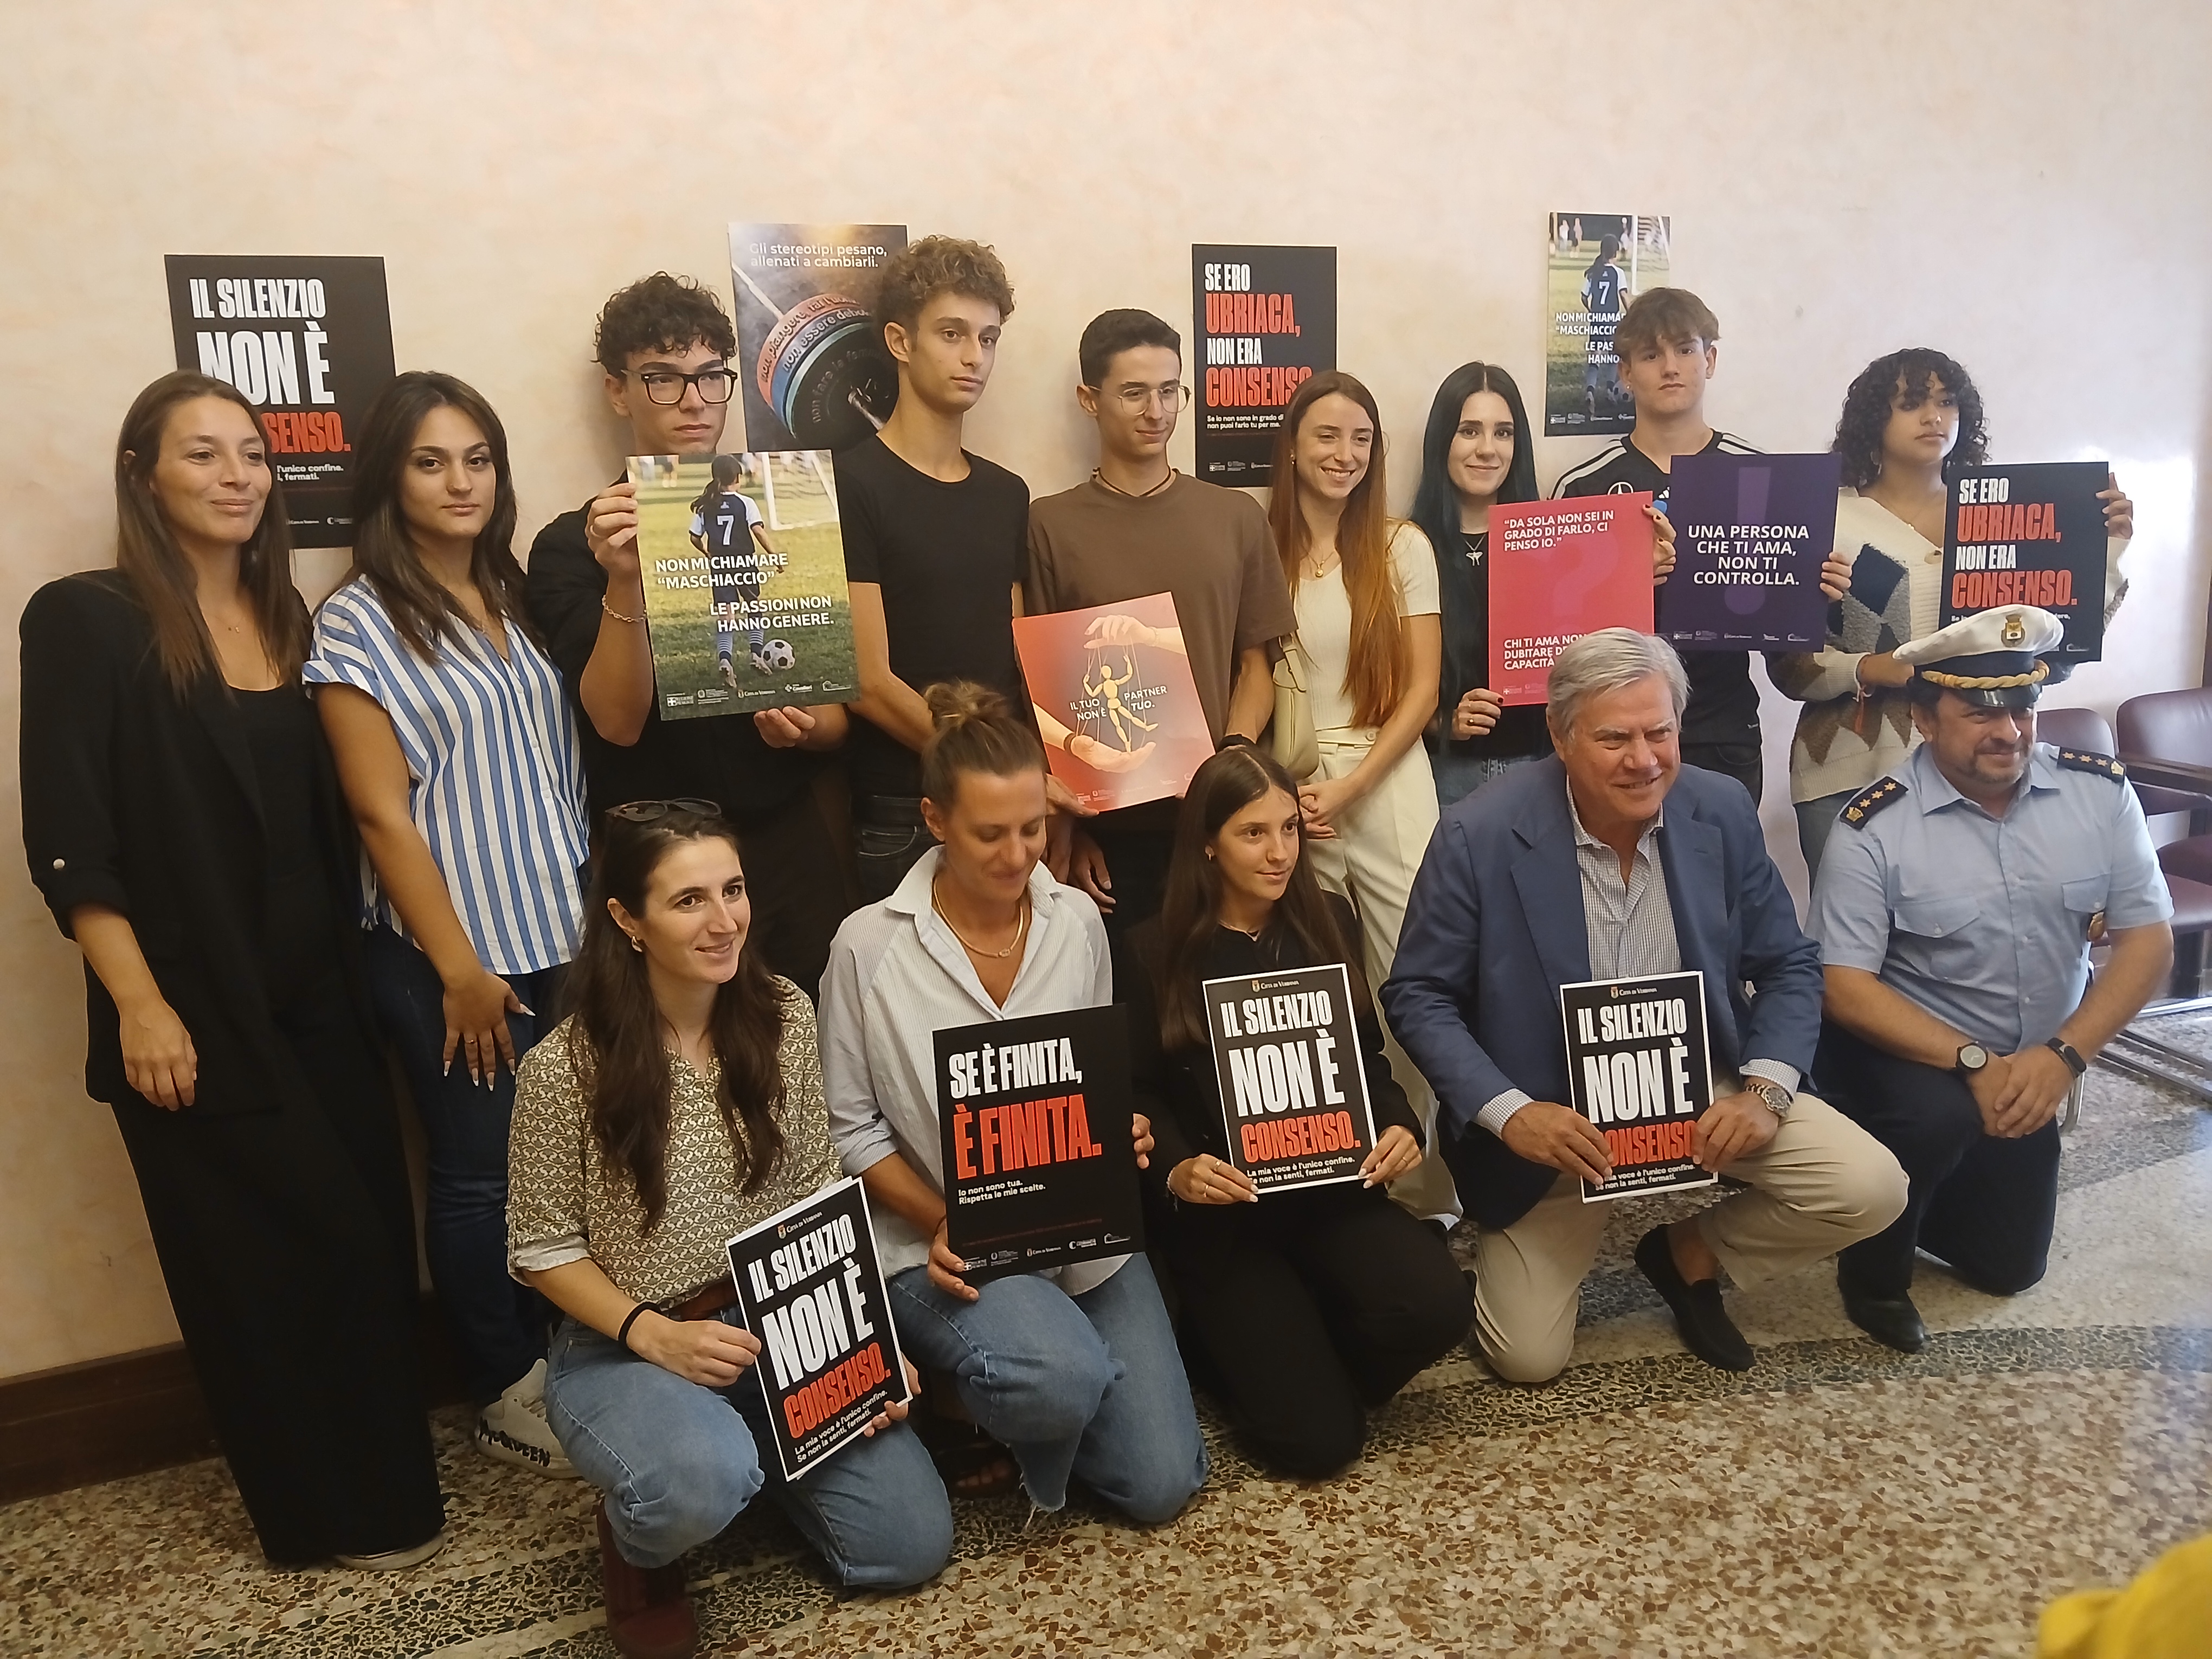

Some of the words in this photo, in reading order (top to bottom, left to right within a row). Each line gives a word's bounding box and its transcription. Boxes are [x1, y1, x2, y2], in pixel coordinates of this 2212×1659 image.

[750, 243, 767, 254] Gli
[770, 243, 833, 256] stereotipi
[837, 246, 887, 257] pesano,
[751, 255, 800, 267] allenati
[803, 258, 811, 267] a
[814, 255, 878, 267] cambiarli.
[1205, 263, 1221, 291] SE
[1224, 263, 1250, 291] ERO
[189, 279, 215, 318] IL
[216, 278, 326, 318] SILENZIO
[1599, 281, 1610, 305] 7
[1205, 293, 1300, 337] UBRIACA,
[1556, 312, 1574, 322] NON
[1576, 313, 1586, 321] MI
[1587, 312, 1626, 322] CHIAMA
[782, 347, 801, 372] non
[800, 316, 836, 348] essere
[1207, 338, 1234, 364] NON
[1237, 338, 1262, 364] ERA
[1585, 342, 1596, 351] LE
[196, 331, 301, 406] NON
[304, 321, 335, 404] È
[1588, 354, 1619, 363] HANNO
[260, 411, 351, 453] SENSO.
[285, 472, 319, 481] fermati.
[308, 464, 344, 472] confine.
[1959, 479, 1978, 504] SE
[1979, 478, 2009, 503] ERO
[717, 515, 734, 545] 7
[1504, 517, 1525, 529] “DA
[1527, 515, 1555, 528] SOLA
[1557, 513, 1582, 524] NON
[1585, 511, 1599, 522] SEI
[1603, 510, 1614, 520] IN
[1957, 503, 2061, 543] UBRIACA,
[1504, 528, 1542, 539] GRADO
[1545, 527, 1555, 536] DI
[1558, 523, 1595, 535] FARLO,
[1597, 522, 1607, 532] CI
[1688, 525, 1725, 538] UNA
[1730, 525, 1809, 538] PERSONA
[1504, 539, 1539, 551] PENSO
[1541, 537, 1562, 548] IO.”
[1697, 541, 1728, 554] CHE
[1734, 541, 1748, 554] TI
[1753, 542, 1797, 556] AMA,
[656, 557, 691, 573] NON
[691, 556, 709, 570] MI
[711, 553, 788, 569] CHIAMARE
[1718, 557, 1757, 569] NON
[1763, 557, 1777, 569] TI
[1956, 545, 1986, 570] NON
[1989, 544, 2016, 569] ERA
[658, 571, 775, 589] “MASCHIACCIO”
[1694, 572, 1799, 585] CONTROLLA.
[1952, 570, 2078, 608] CONSENSO.
[710, 602, 727, 615] LE
[731, 597, 799, 614] PASSIONI
[800, 595, 831, 608] NON
[717, 616, 770, 632] HANNO
[772, 613, 834, 628] GENERE.
[1504, 639, 1521, 648] CHI
[1523, 638, 1533, 647] TI
[1535, 635, 1559, 646] AMA
[1504, 646, 1553, 659] DUBITARE
[1504, 658, 1555, 670] CAPACITÀ
[1070, 702, 1078, 711] IL
[1079, 698, 1100, 709] TUO
[1124, 685, 1167, 701] PARTNER
[1077, 711, 1099, 721] NON
[1100, 707, 1107, 717] È
[1131, 700, 1155, 711] TUO.
[1220, 1002, 1243, 1038] IL
[1242, 990, 1333, 1034] SILENZIO
[1577, 1008, 1598, 1044] IL
[1599, 999, 1687, 1042] SILENZIO
[949, 1051, 981, 1098] SE
[982, 1043, 998, 1094] È
[999, 1038, 1082, 1090] FINITA,
[1229, 1040, 1316, 1117] NON
[1316, 1028, 1345, 1105] È
[1583, 1049, 1666, 1123] NON
[1669, 1037, 1694, 1114] È
[953, 1103, 976, 1180] È
[979, 1094, 1102, 1175] FINITA.
[1240, 1111, 1361, 1163] CONSENSO.
[1258, 1167, 1271, 1175] mia
[1298, 1160, 1323, 1169] l'unico
[1324, 1156, 1355, 1166] confine.
[1284, 1171, 1304, 1180] senti,
[1306, 1166, 1334, 1176] fermati.
[1668, 1164, 1695, 1173] confine.
[968, 1186, 983, 1195] non
[986, 1183, 1005, 1192] sono
[1628, 1177, 1647, 1185] senti,
[1649, 1173, 1676, 1182] fermati.
[959, 1193, 993, 1205] Rispetta
[1004, 1188, 1018, 1196] mie
[1020, 1184, 1046, 1193] scelte.
[748, 1258, 774, 1303] IL
[771, 1214, 856, 1291] SILENZIO
[761, 1277, 851, 1391] NON
[844, 1257, 874, 1342] È
[783, 1342, 891, 1438] CONSENSO.
[795, 1445, 805, 1455] La
[806, 1437, 818, 1448] mia
[819, 1425, 835, 1438] voce
[841, 1407, 861, 1424] l'unico
[863, 1390, 888, 1409] confine.
[797, 1454, 807, 1463] Se
[808, 1444, 821, 1456] non
[829, 1427, 847, 1442] senti,
[847, 1408, 871, 1429] fermati.
